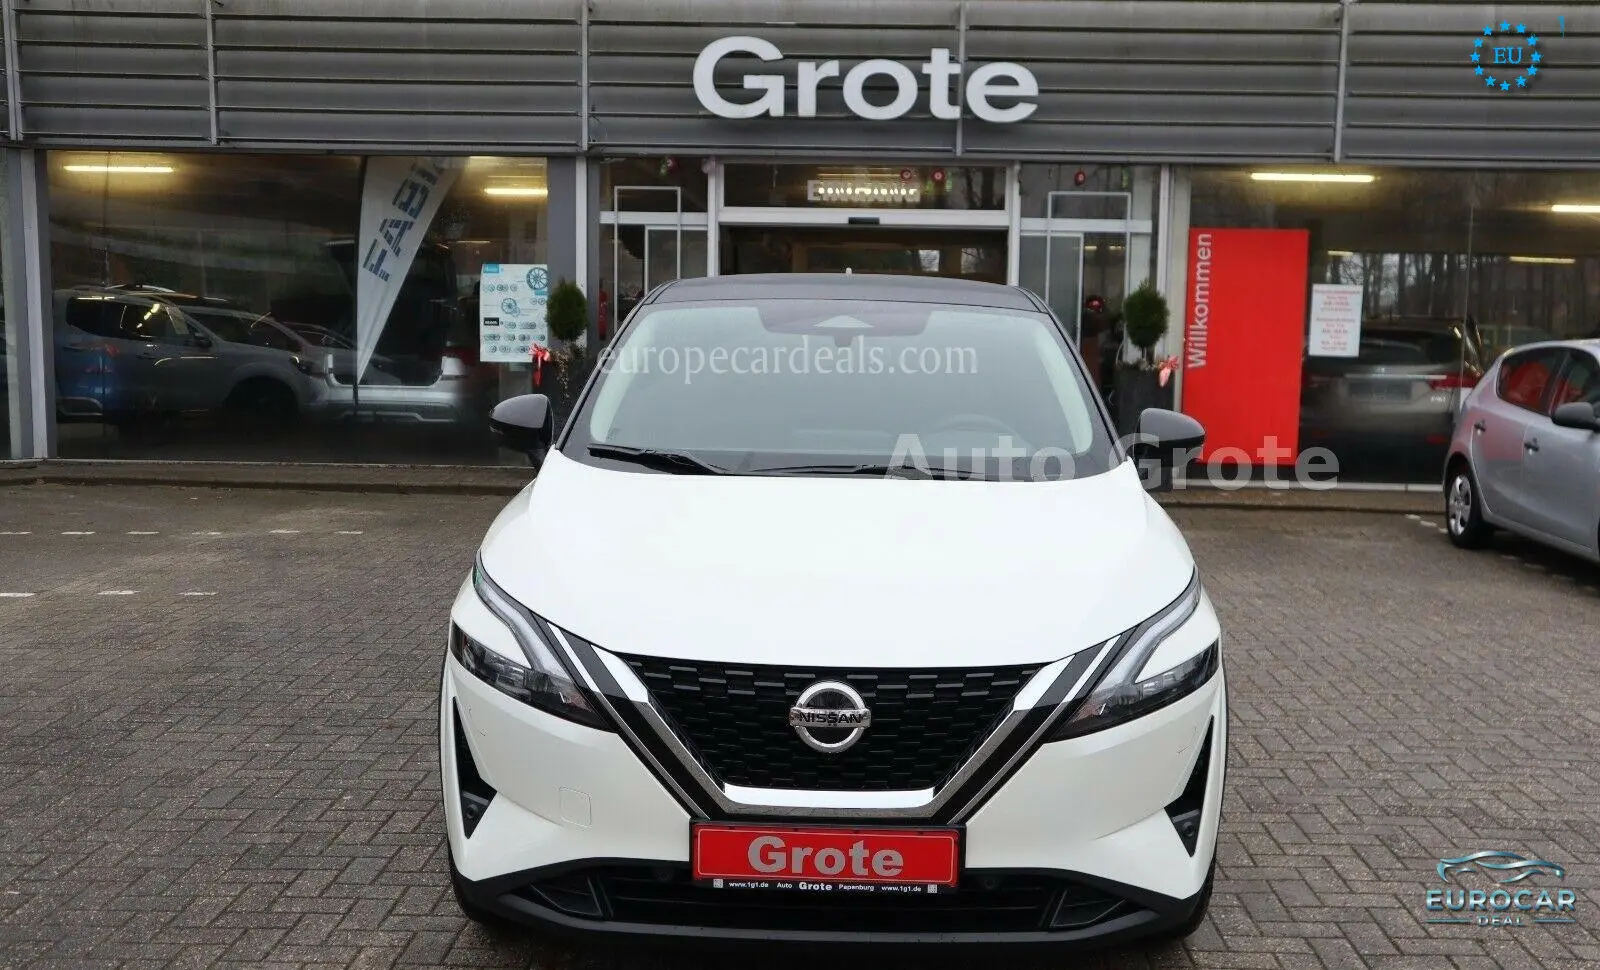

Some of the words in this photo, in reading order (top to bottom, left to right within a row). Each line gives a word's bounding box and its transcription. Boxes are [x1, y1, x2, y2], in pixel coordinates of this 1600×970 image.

[693, 36, 1039, 123] Grote
[1188, 233, 1212, 368] Willkommen
[800, 711, 863, 724] NISSAN
[747, 835, 904, 877] Grote
[728, 881, 769, 889] www.1g1.de
[776, 881, 793, 889] Auto
[798, 881, 833, 891] Grote
[838, 883, 875, 892] Papenburg
[881, 885, 922, 893] www.1g1.de
